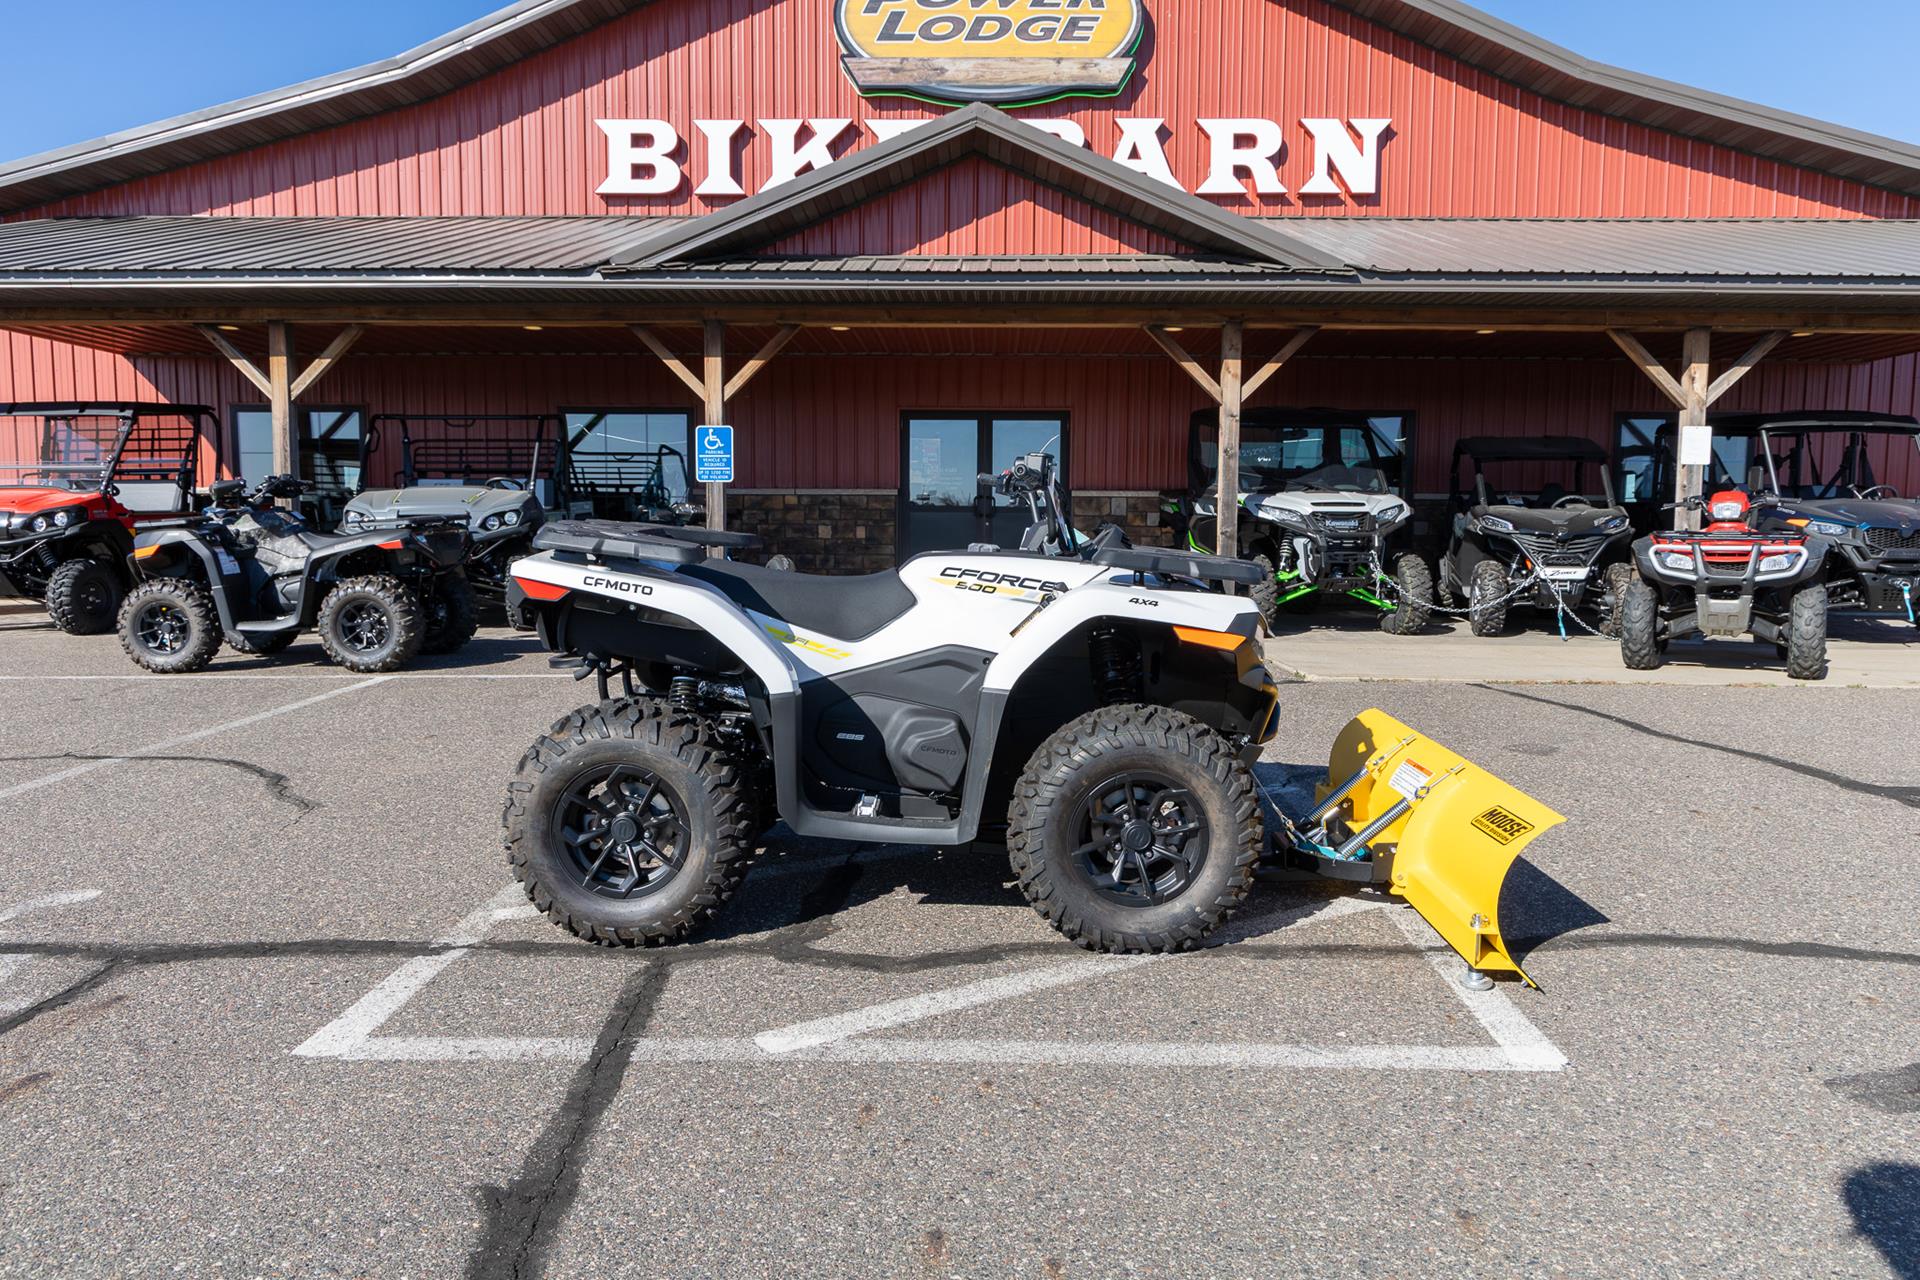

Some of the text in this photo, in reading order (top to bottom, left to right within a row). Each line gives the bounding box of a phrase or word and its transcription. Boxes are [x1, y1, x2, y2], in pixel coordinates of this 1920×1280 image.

[876, 10, 1100, 42] LODGE
[593, 118, 922, 194] BIK
[583, 576, 654, 596] CFMOTO
[940, 566, 1058, 593] CFORCE
[955, 581, 997, 594] 500
[920, 745, 957, 757] CFMOTO
[1481, 808, 1529, 837] MOOSE
